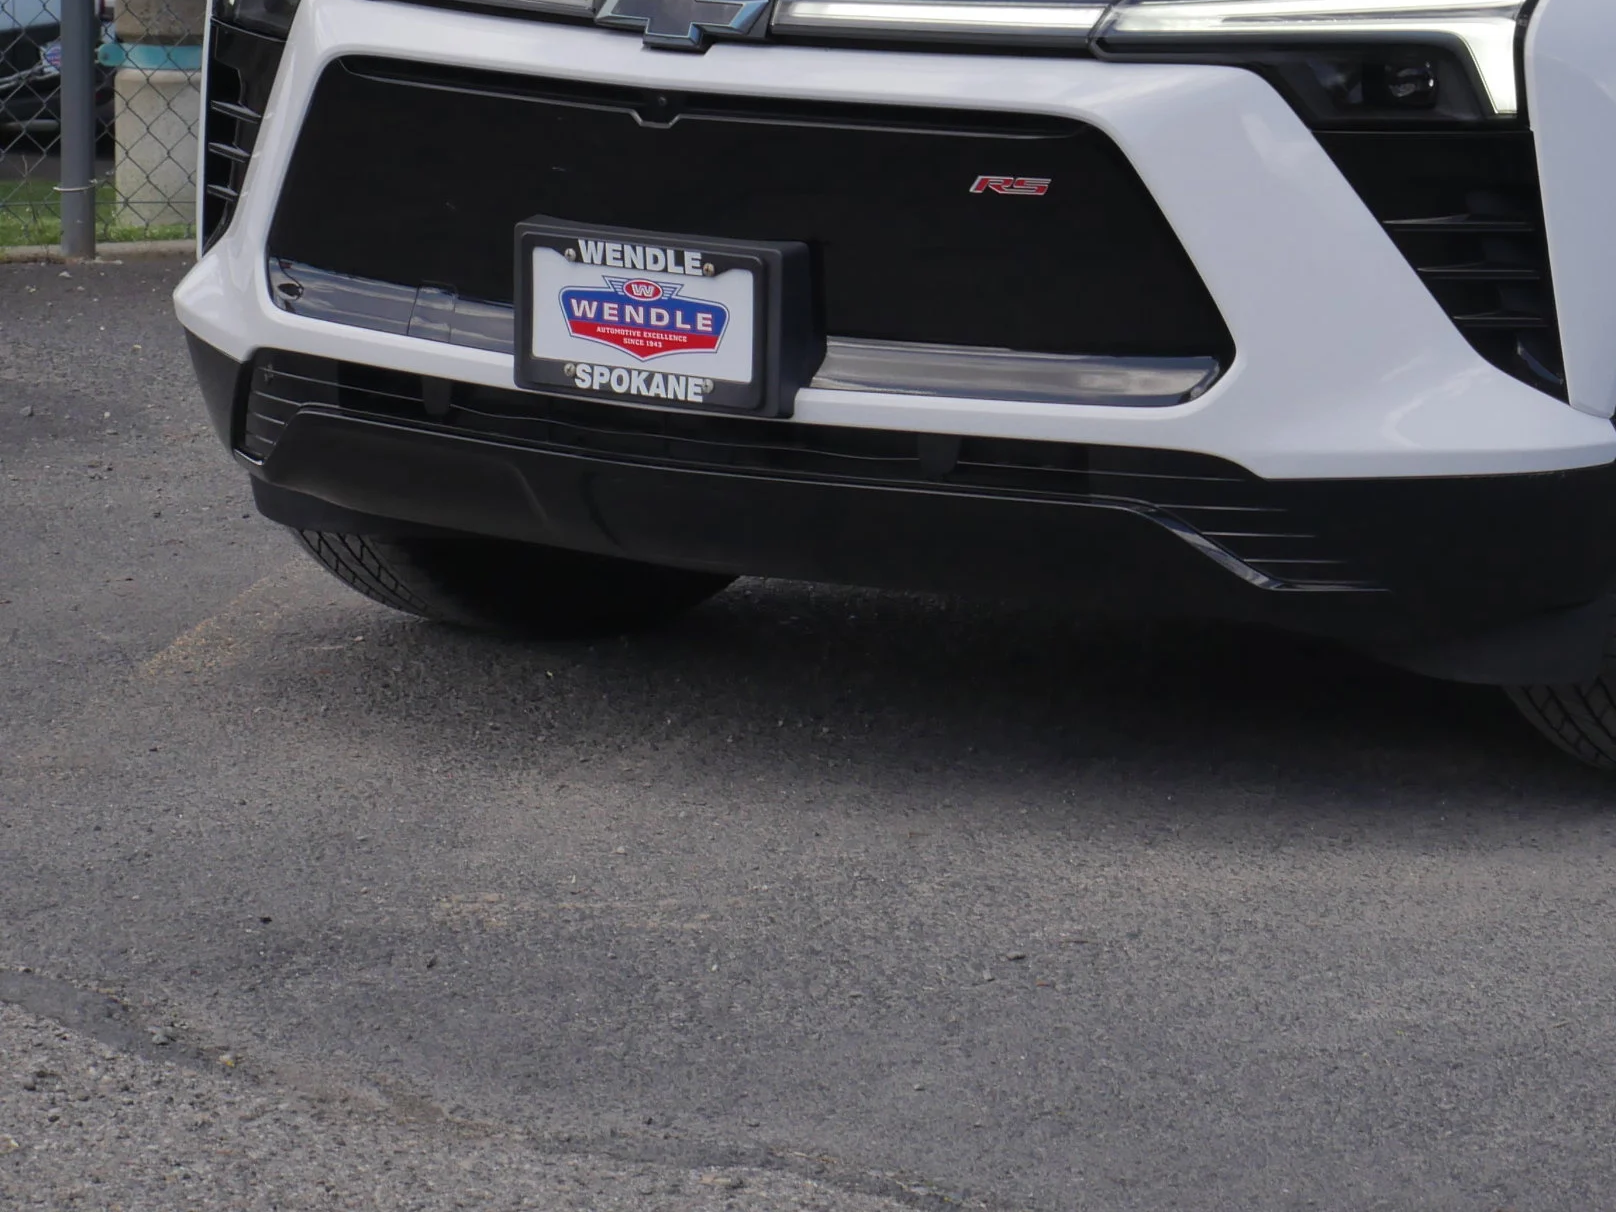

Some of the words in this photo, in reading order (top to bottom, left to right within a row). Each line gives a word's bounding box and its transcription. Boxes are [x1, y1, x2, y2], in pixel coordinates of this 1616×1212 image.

[969, 175, 1052, 195] RS
[578, 239, 703, 276] WENDLE
[570, 299, 713, 331] WENDLE
[596, 326, 641, 337] AUTOMOTIVE
[643, 331, 688, 343] EXCELLENCE
[623, 338, 645, 346] SINCE
[574, 363, 703, 403] SPOKANE
